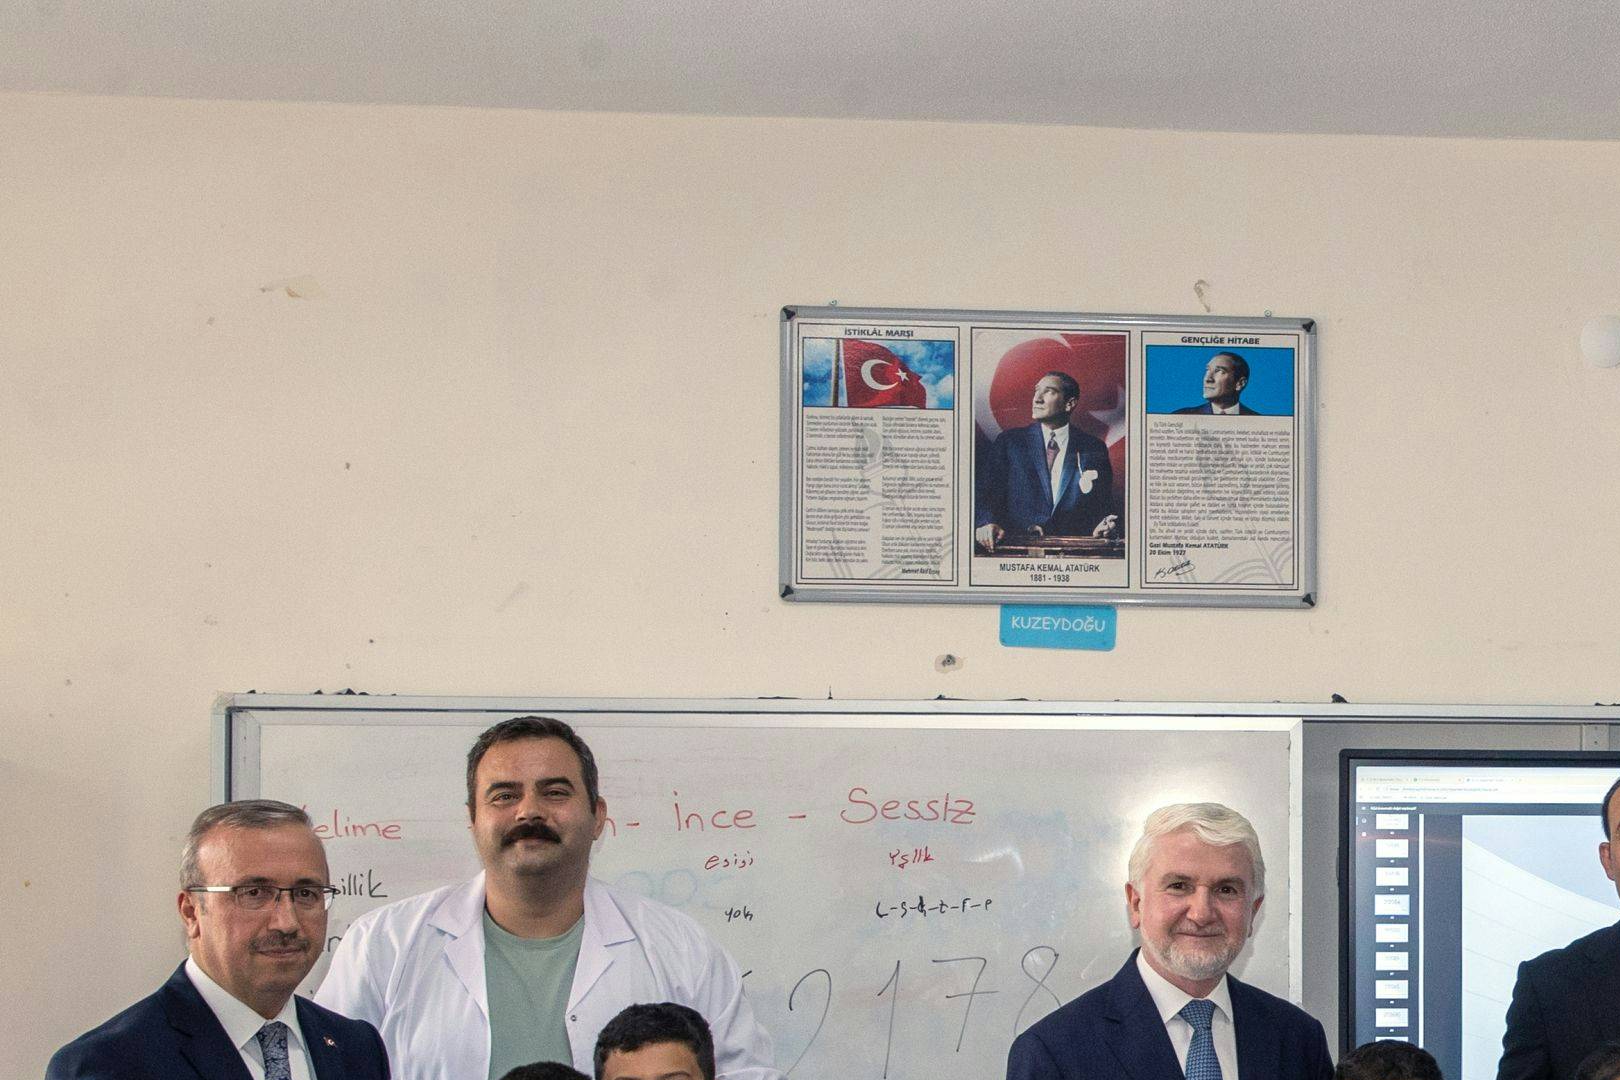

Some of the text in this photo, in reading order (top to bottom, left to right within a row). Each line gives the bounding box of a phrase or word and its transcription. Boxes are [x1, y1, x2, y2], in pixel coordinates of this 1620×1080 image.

[1181, 335, 1260, 345] GENÇLİĞE HİTABE
[1000, 563, 1100, 573] MUSTAFA KEMAL ATATÜRK
[1030, 574, 1046, 582] 1881
[1053, 574, 1070, 583] 1938
[1011, 615, 1106, 632] KUZEYDOĞU
[303, 805, 402, 840] elime
